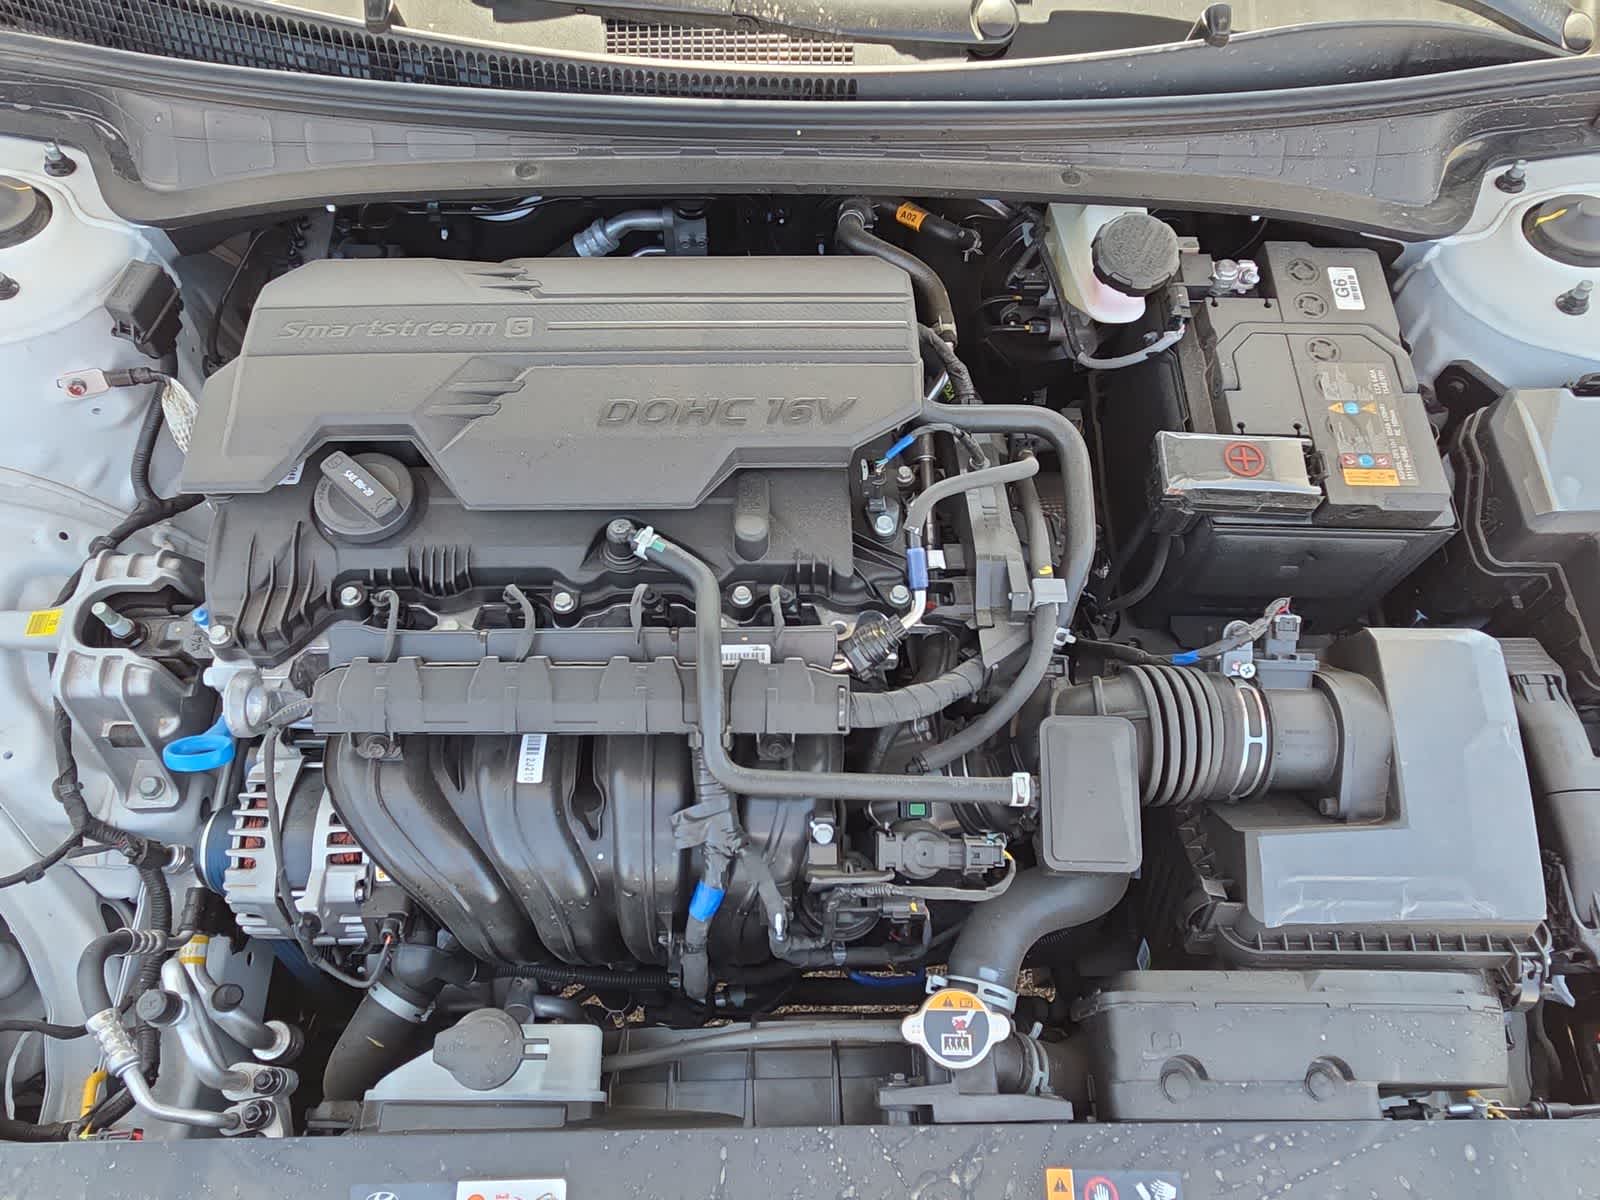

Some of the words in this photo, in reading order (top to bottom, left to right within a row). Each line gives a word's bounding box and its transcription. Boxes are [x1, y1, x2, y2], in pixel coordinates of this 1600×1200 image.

[1332, 278, 1351, 298] G6
[279, 319, 498, 338] Smartstream
[597, 396, 755, 425] DOHC
[766, 396, 857, 425] 16V
